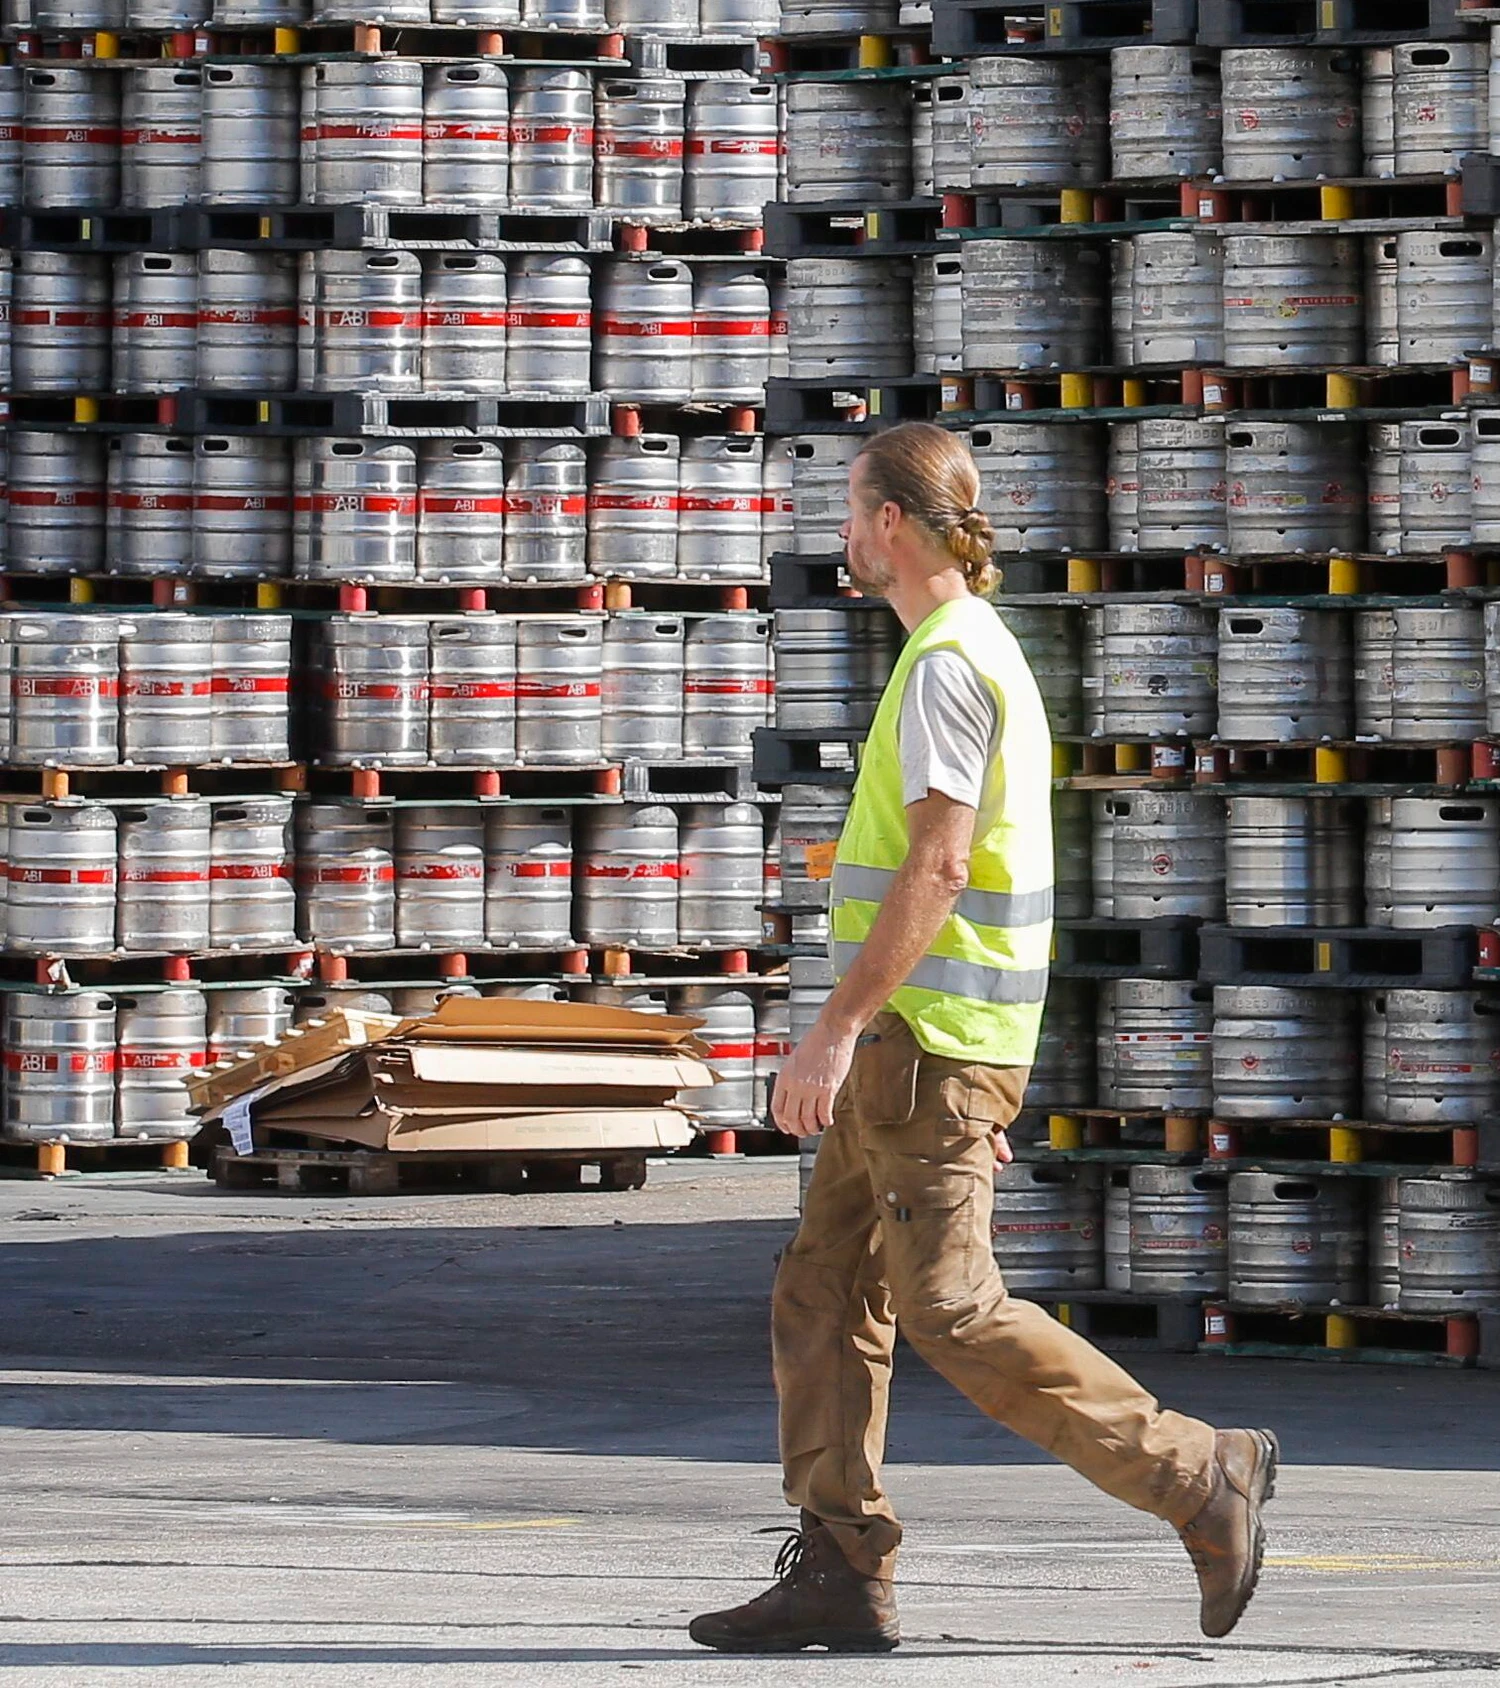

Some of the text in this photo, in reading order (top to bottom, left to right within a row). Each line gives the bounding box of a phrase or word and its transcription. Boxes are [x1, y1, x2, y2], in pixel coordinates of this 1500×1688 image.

[0, 127, 12, 140] BI
[65, 130, 88, 143] ABI
[0, 304, 9, 321] BI
[232, 311, 255, 323] ABI
[339, 310, 369, 327] ABI
[143, 314, 163, 326] ABI
[442, 313, 465, 326] ABI
[640, 323, 662, 335] ABI
[54, 494, 76, 506] ABI
[244, 497, 266, 510] ABI
[334, 496, 365, 512] ABI
[454, 499, 475, 512] ABI
[733, 497, 752, 510] ABI
[233, 679, 256, 691] ABI
[567, 683, 587, 696] ABI
[23, 870, 43, 883] ABI
[251, 866, 273, 879] ABI
[20, 1055, 46, 1072] ABI
